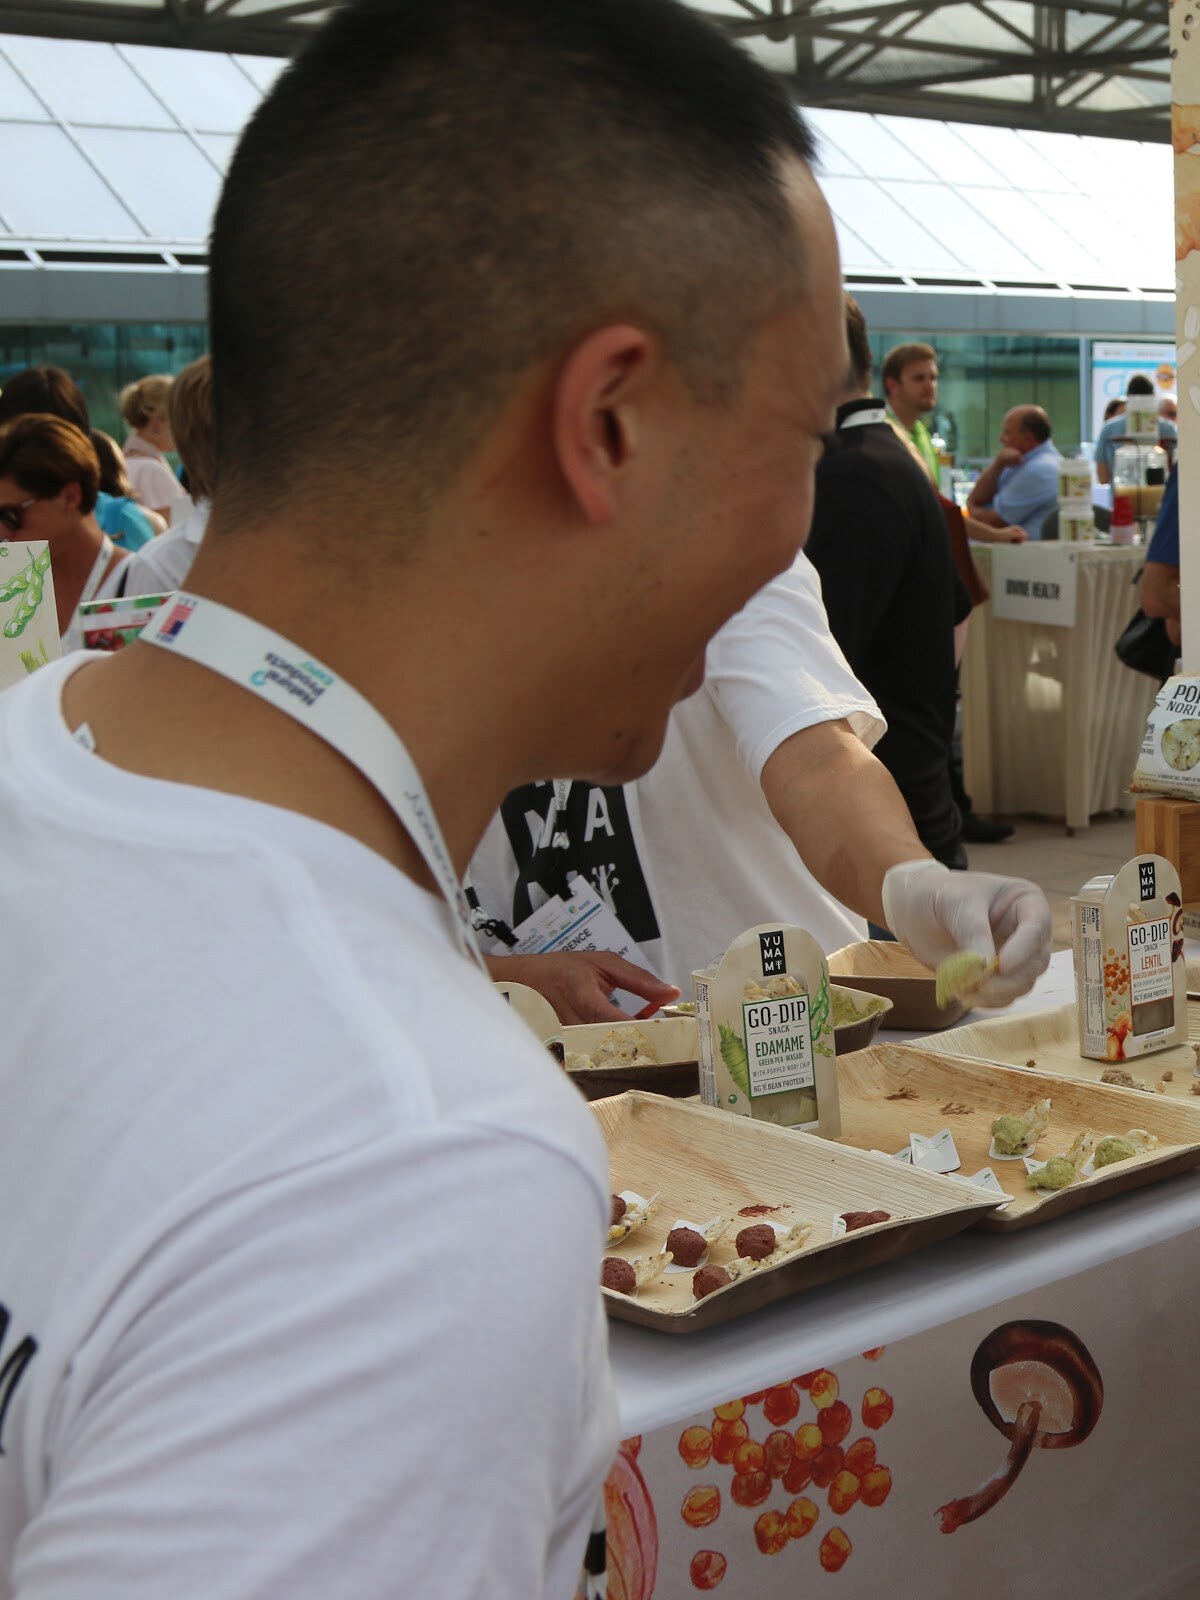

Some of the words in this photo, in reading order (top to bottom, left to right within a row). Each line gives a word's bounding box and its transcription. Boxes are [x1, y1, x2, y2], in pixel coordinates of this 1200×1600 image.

[264, 652, 327, 698] Products
[265, 668, 316, 706] Natural
[1166, 701, 1197, 716] NORI
[1141, 865, 1153, 876] YU
[1141, 877, 1154, 887] MA
[764, 935, 781, 947] YU
[1130, 922, 1169, 946] GO-DIP
[763, 948, 782, 959] MA
[1144, 943, 1158, 952] SNACK
[1141, 954, 1162, 970] LENTIL
[748, 1001, 806, 1028] GO-DIP
[768, 1025, 790, 1035] SNACK
[755, 1035, 805, 1058] EDAMAME
[752, 1069, 766, 1077] WITH
[767, 1066, 786, 1075] POPPED
[786, 1064, 799, 1072] NORI
[799, 1061, 811, 1069] CHIP
[758, 1058, 774, 1067] GREEN
[767, 1081, 782, 1090] BEAN
[782, 1077, 805, 1088] PROTEIN
